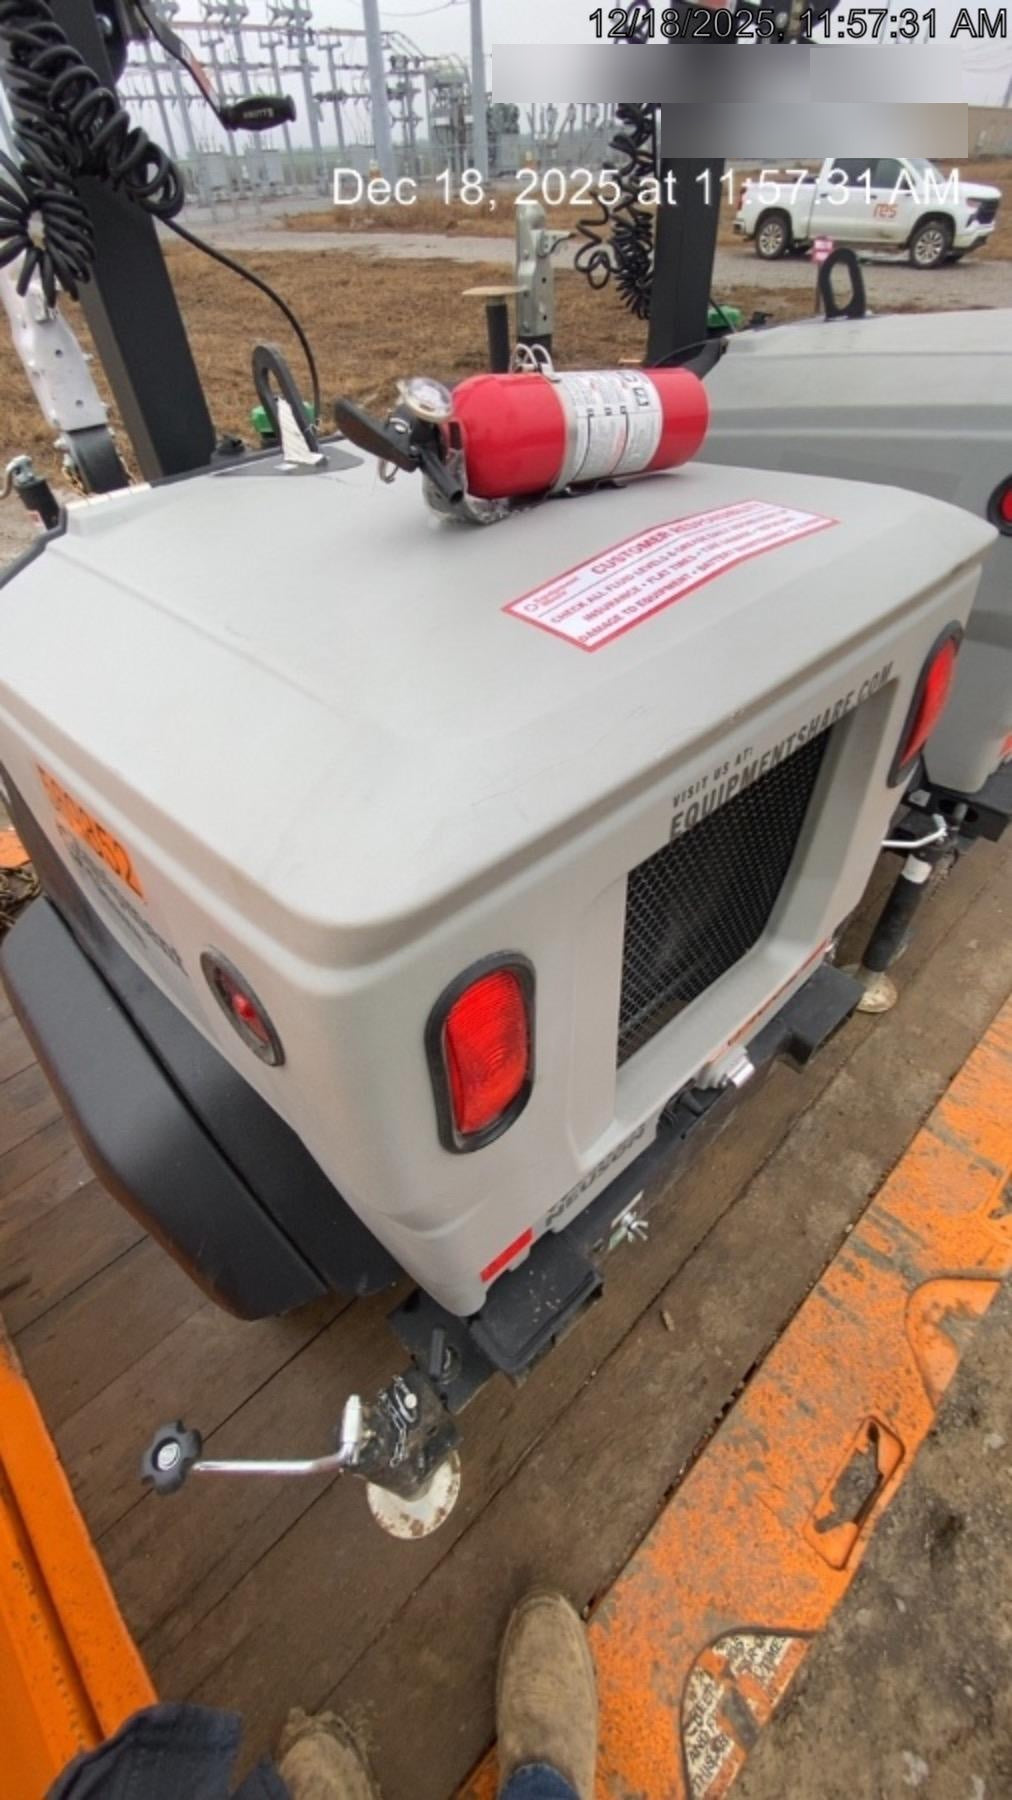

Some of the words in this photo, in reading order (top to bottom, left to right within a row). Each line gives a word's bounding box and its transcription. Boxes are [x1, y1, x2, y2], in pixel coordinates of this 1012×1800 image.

[872, 203, 899, 218] res
[591, 531, 671, 575] CUSTOMER
[550, 601, 587, 623] CHECK
[672, 775, 708, 808] VISIT
[713, 760, 730, 780] US
